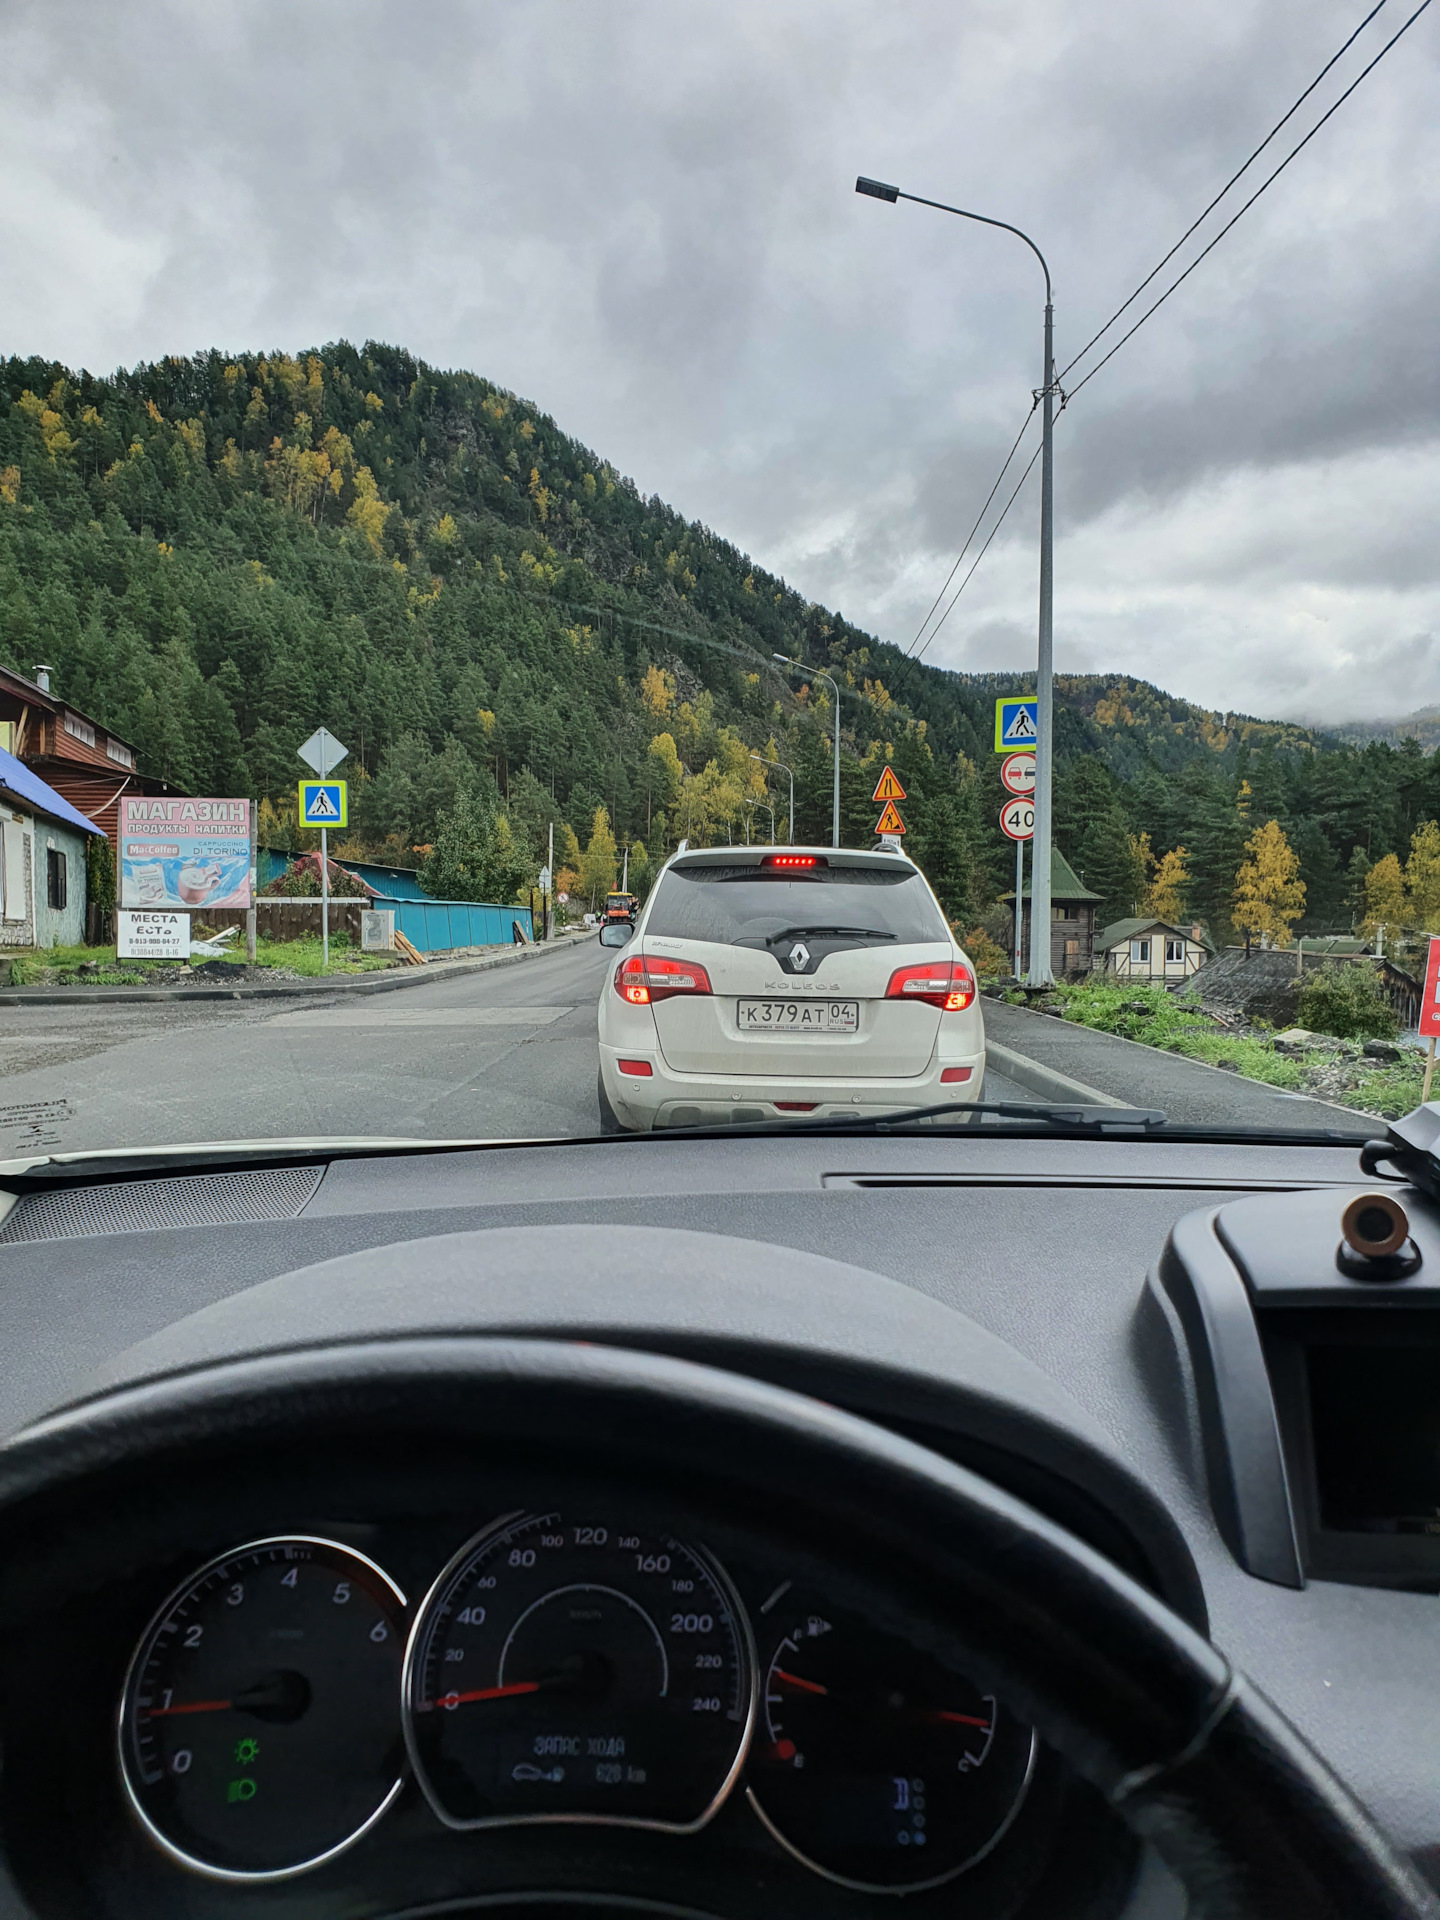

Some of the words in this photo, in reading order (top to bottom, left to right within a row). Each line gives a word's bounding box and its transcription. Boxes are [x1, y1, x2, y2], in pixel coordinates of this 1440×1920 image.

[127, 801, 245, 821] МАГАЗИН
[1008, 810, 1035, 827] 40
[127, 823, 189, 834] ПРОДУКТЫ
[195, 824, 247, 835] НАПИТКИ
[129, 844, 179, 855] MacCoffee
[207, 848, 248, 856] TORINO
[131, 914, 178, 923] МЕСТА
[136, 926, 172, 934] ЕСТЬ
[764, 981, 840, 990] KOLEOS
[831, 1004, 850, 1018] 04
[541, 1535, 564, 1547] 100
[573, 1527, 608, 1545] 120
[618, 1536, 640, 1549] 140
[508, 1550, 536, 1567] 80
[636, 1554, 671, 1573] 160
[281, 1566, 299, 1588] 4
[477, 1576, 497, 1589] 60
[672, 1579, 694, 1592] 180
[227, 1583, 245, 1606] 3
[332, 1583, 351, 1604] 5
[456, 1607, 486, 1625] 40
[670, 1614, 713, 1632] 200
[183, 1624, 204, 1647] 2
[369, 1620, 388, 1642] 6
[445, 1649, 465, 1662] 20
[695, 1655, 722, 1668] 220
[162, 1688, 173, 1709] 1
[692, 1698, 721, 1712] 240
[534, 1736, 581, 1756] ЗАПАС
[587, 1737, 625, 1757] ХОДА
[172, 1749, 192, 1773] 0
[893, 1778, 909, 1810] D
